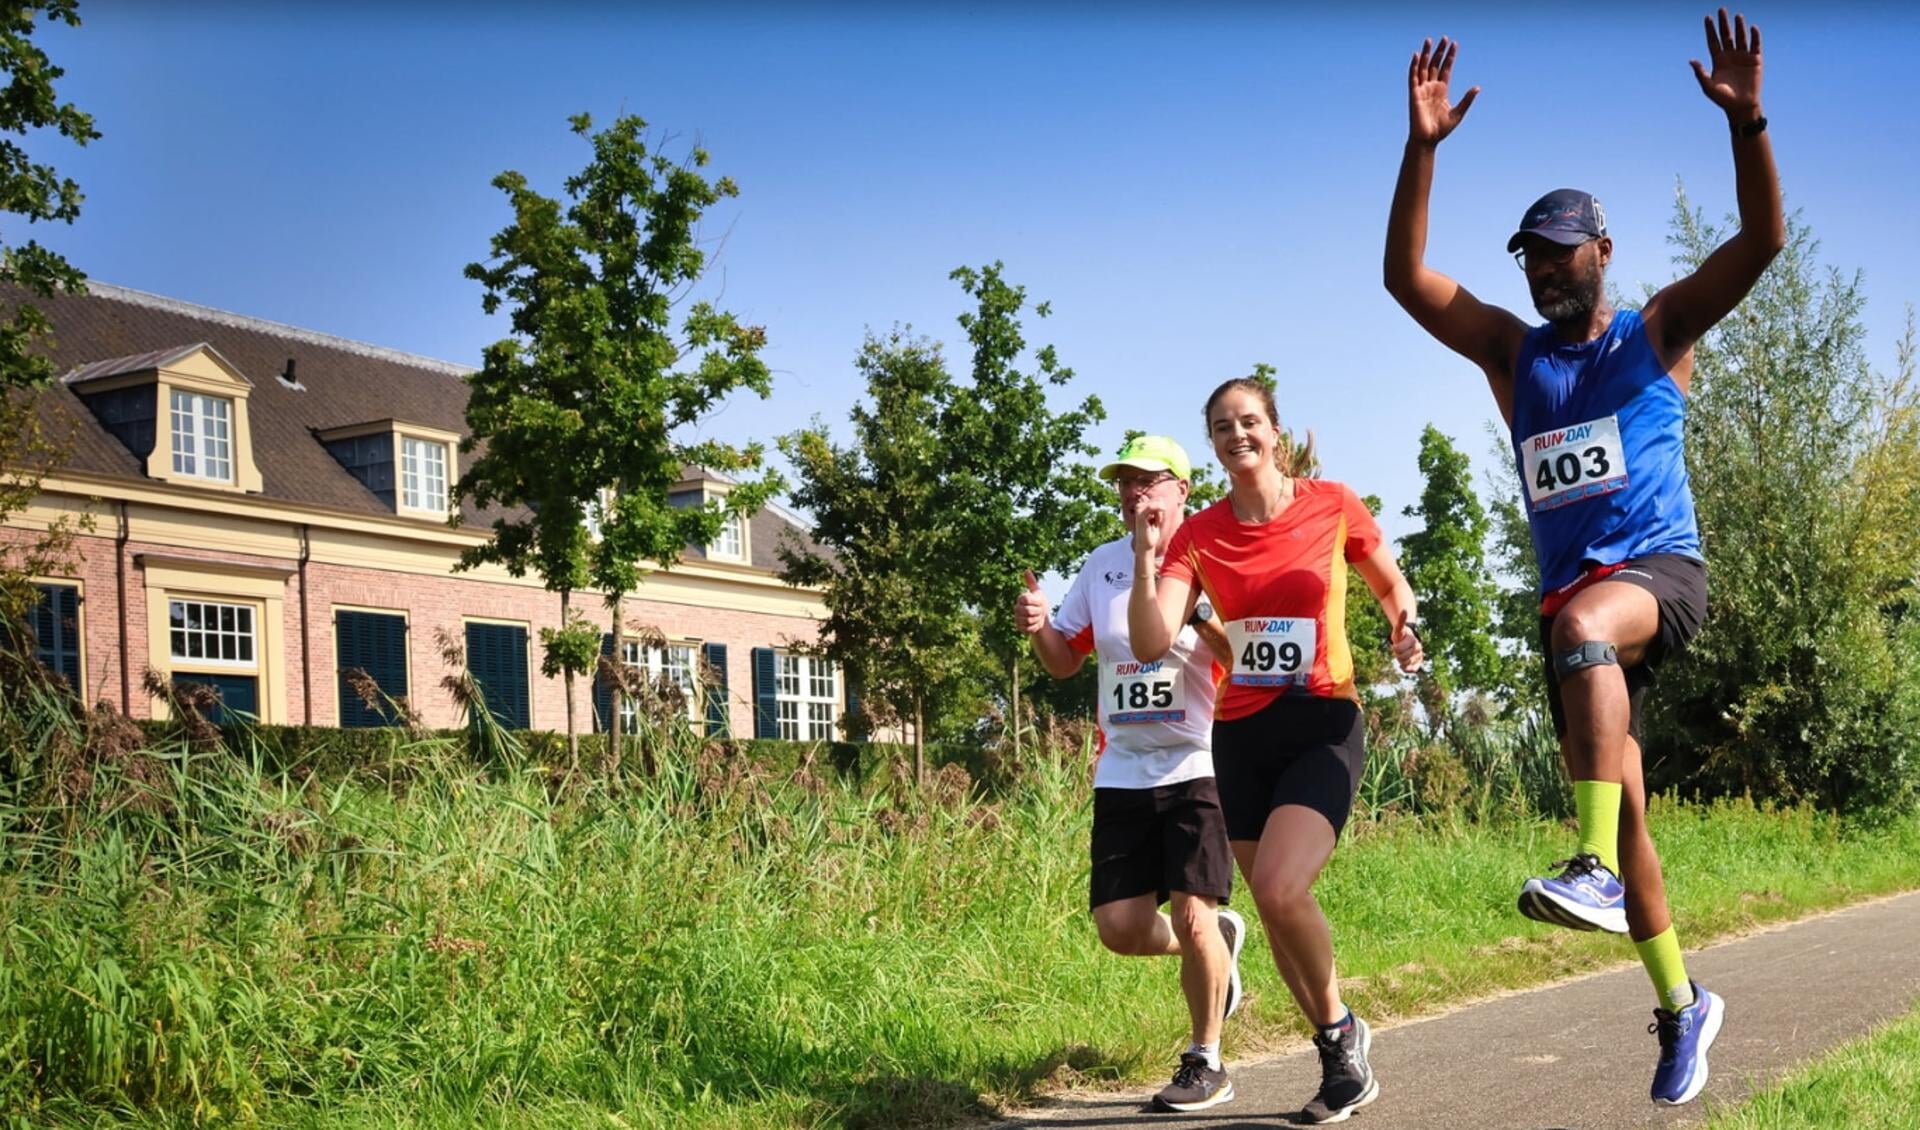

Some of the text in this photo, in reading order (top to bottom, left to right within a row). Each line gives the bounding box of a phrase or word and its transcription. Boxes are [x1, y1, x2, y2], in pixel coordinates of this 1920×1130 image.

[1536, 446, 1610, 491] 403
[1241, 641, 1302, 672] 499
[1113, 681, 1173, 710] 185
